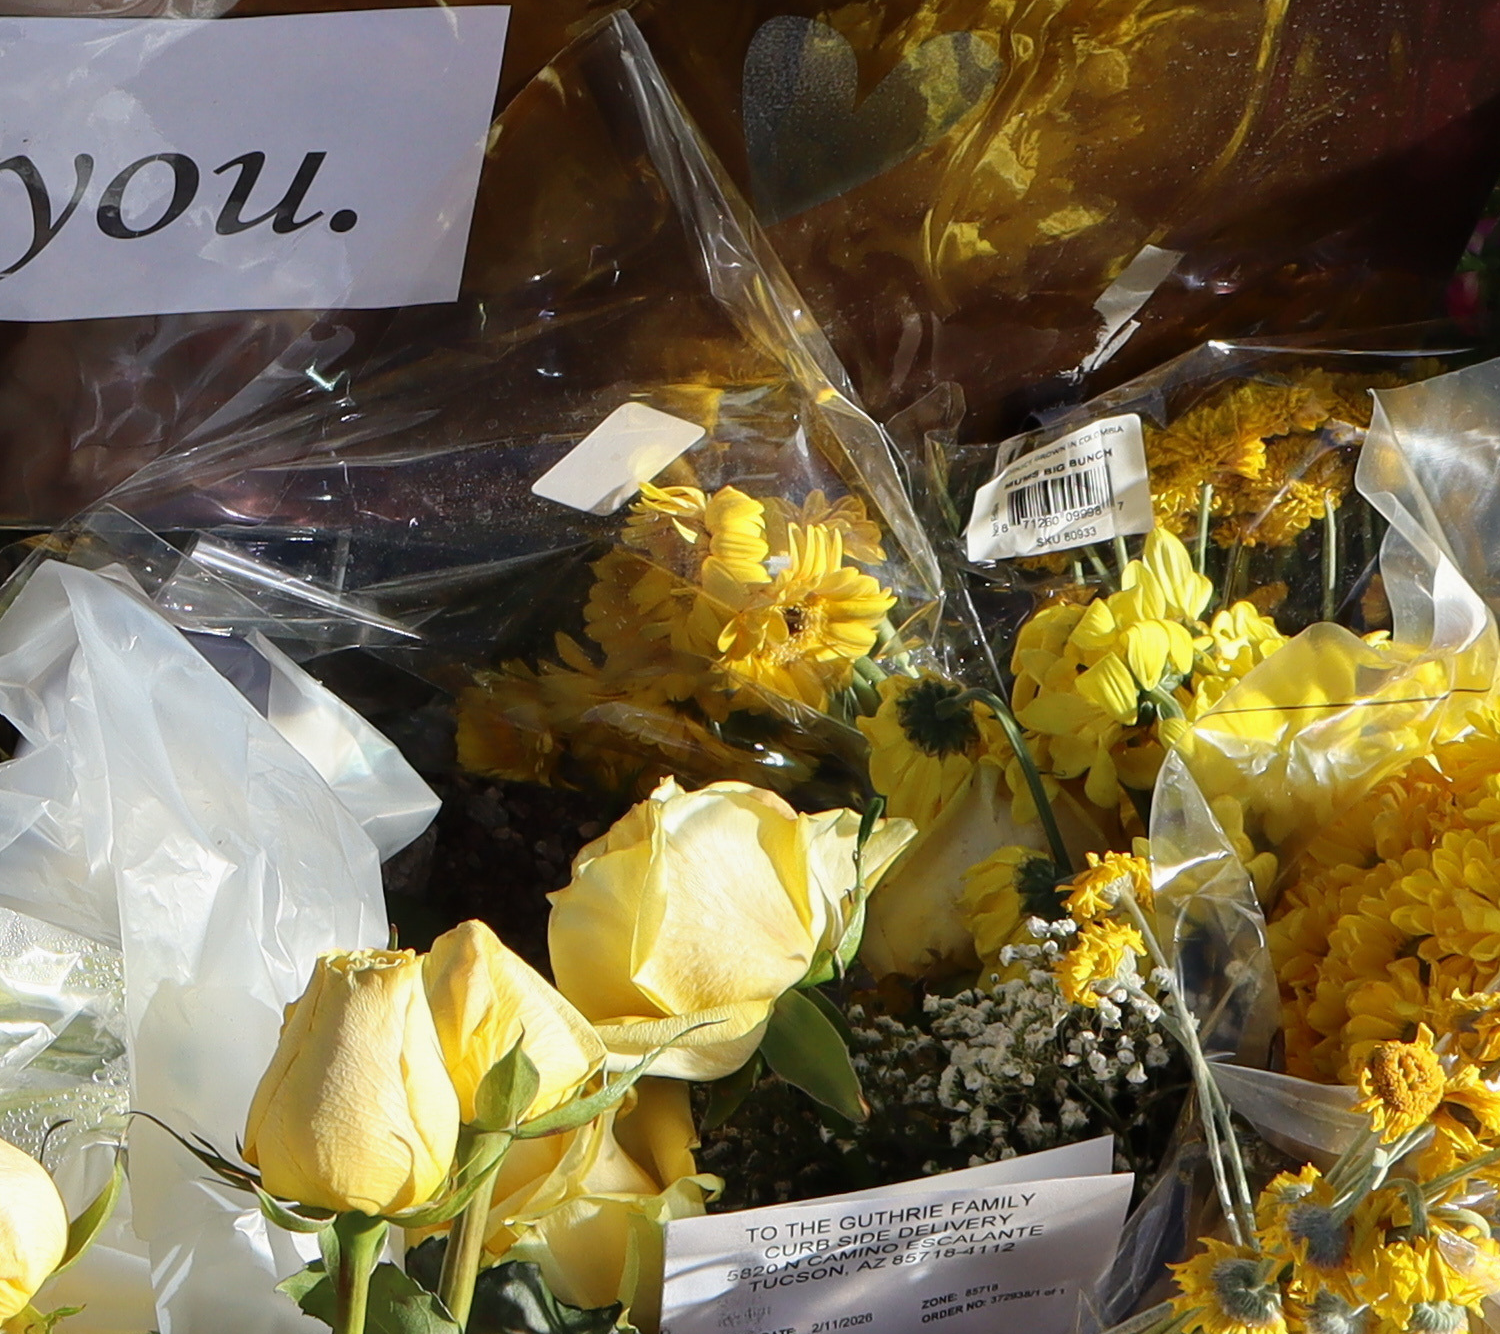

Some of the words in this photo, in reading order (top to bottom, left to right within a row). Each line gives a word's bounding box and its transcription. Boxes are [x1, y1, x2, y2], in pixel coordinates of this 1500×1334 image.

[1078, 425, 1125, 444] COLOMBIA
[1004, 470, 1040, 489] MUMS
[1044, 463, 1066, 477] BIG
[1069, 448, 1114, 468] BUNCH
[1036, 534, 1062, 548] SKU
[746, 1226, 778, 1243] TO
[785, 1218, 832, 1239] THE
[839, 1203, 944, 1231] GUTHRIE
[951, 1192, 1036, 1216] FAMILY
[765, 1239, 830, 1259] CURB
[837, 1229, 891, 1248] SIDE
[897, 1213, 1014, 1239] DELIVERY
[727, 1263, 778, 1283] 5820
[784, 1259, 800, 1271] N
[807, 1243, 899, 1268] CAMINO
[905, 1224, 1045, 1250] ESCALANTE
[750, 1265, 850, 1293] TUCSON,
[856, 1257, 887, 1272] AZ
[891, 1242, 1016, 1267] 85718-4112
[921, 1292, 958, 1310] ZONE:
[965, 1283, 1000, 1298] 85718
[921, 1305, 964, 1324] ORDER
[966, 1299, 988, 1312] NO:
